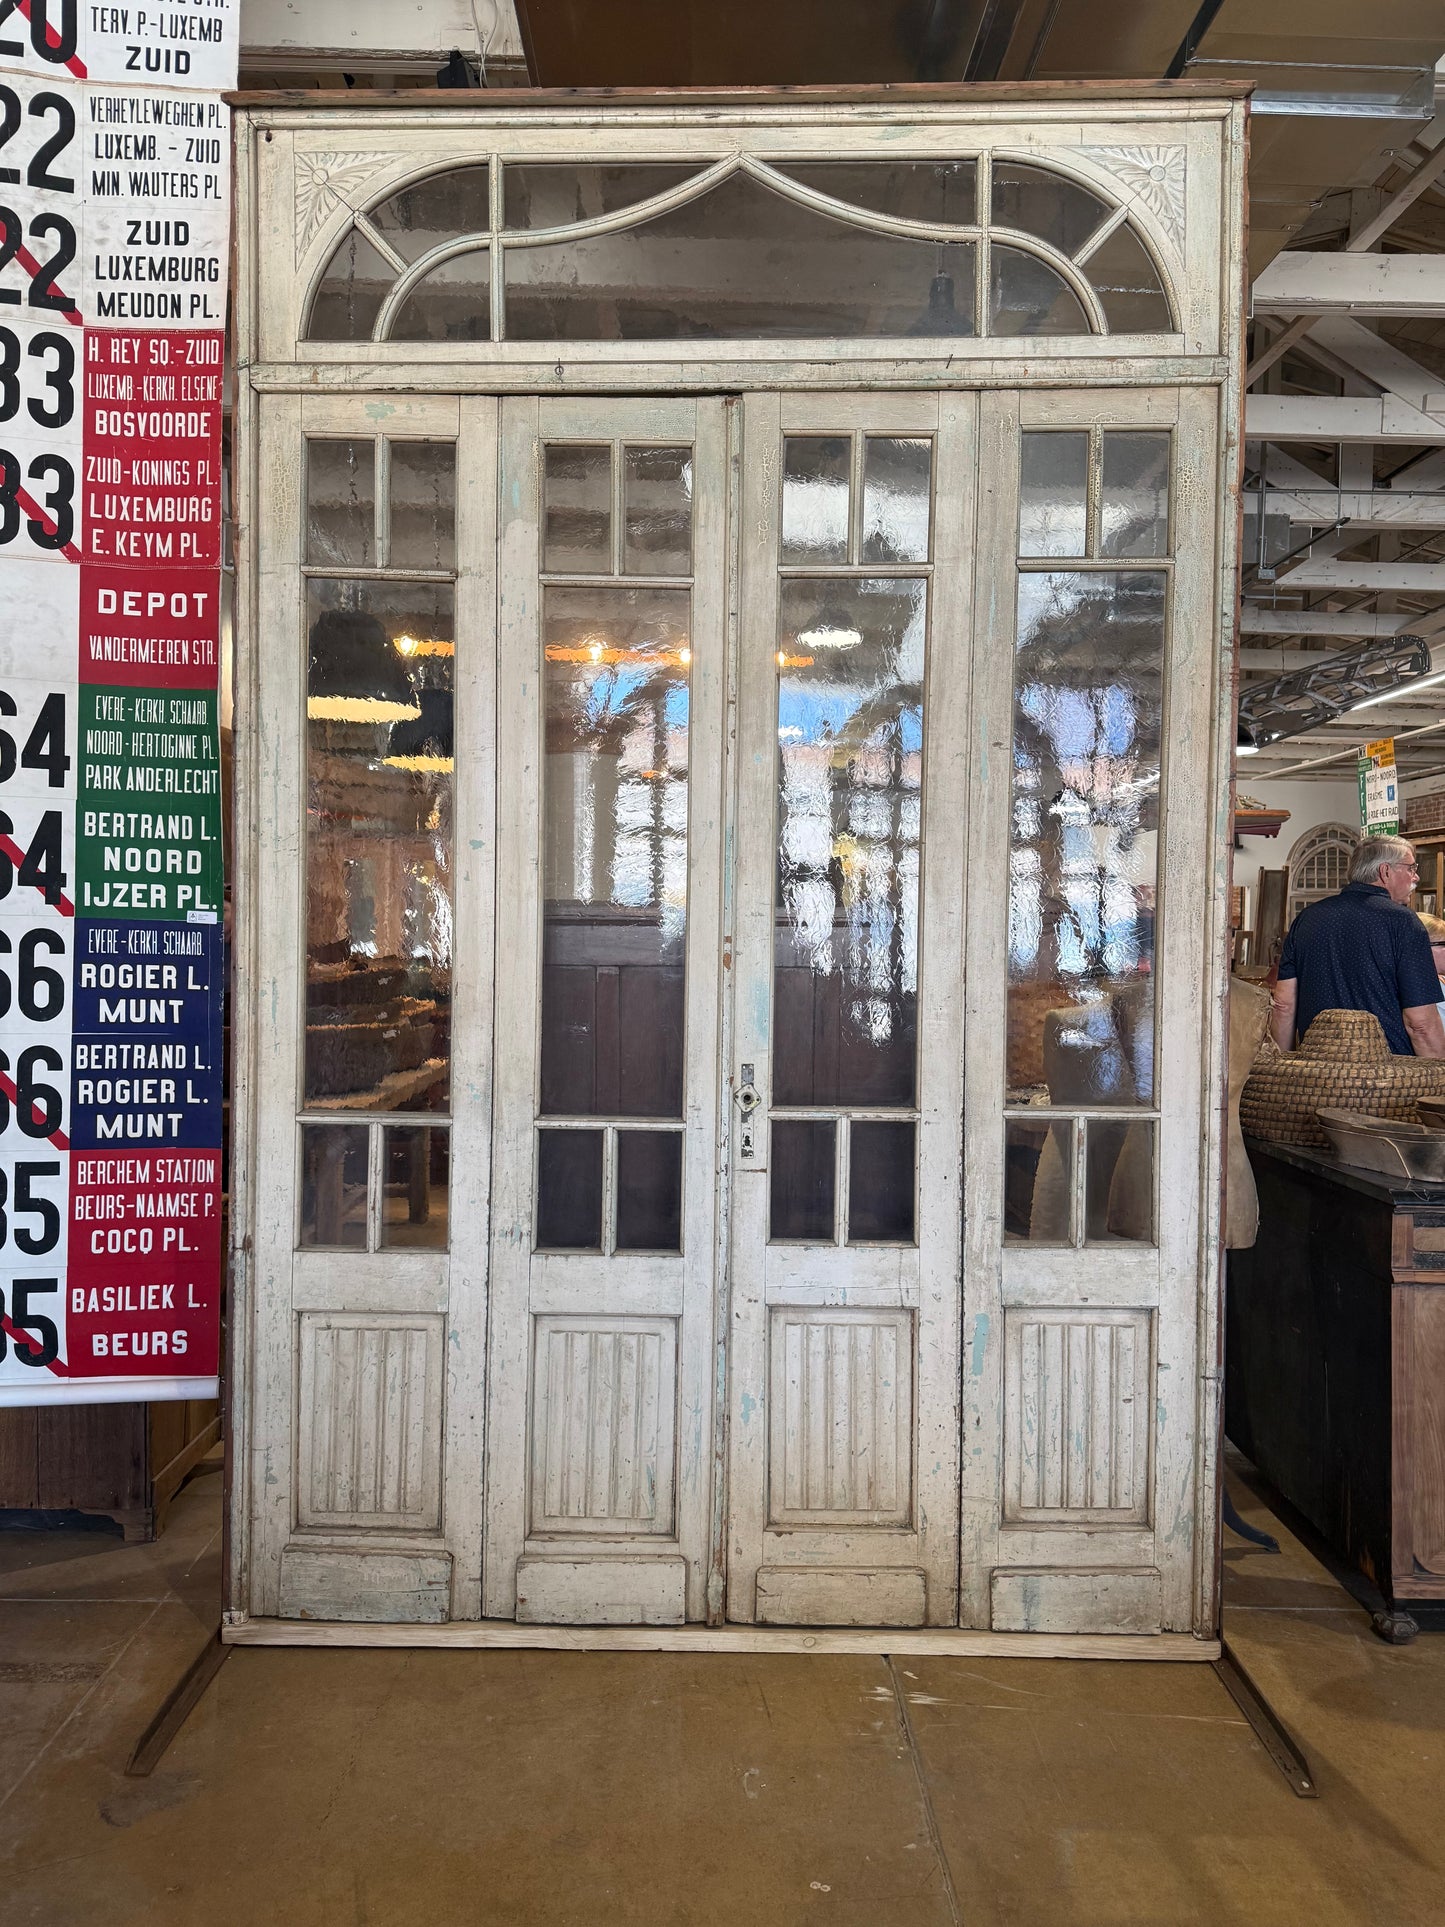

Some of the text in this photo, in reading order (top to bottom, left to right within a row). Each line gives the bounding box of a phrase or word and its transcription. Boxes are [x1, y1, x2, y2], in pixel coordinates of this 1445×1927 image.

[91, 6, 222, 42] TERV. P.-LUXEMB
[126, 46, 190, 74] ZUID
[90, 96, 226, 128] VERHEYLEWEGHEN PL.
[95, 133, 160, 160] LUXEMB.
[185, 137, 220, 163] ZUID
[92, 170, 222, 199] MIN. WAUTERS PL
[126, 220, 190, 246] ZUID
[95, 255, 219, 282] LUXEMBURG
[97, 291, 220, 319] MEUDON PL.
[88, 336, 219, 366] H. REY SQ.-ZUID
[88, 372, 218, 401] LUXEMB.-KERKH. ELSENE
[95, 409, 211, 438] BOSVOORDE
[86, 455, 218, 485] ZUID-KONINGS PL.
[90, 492, 212, 522] LUXEMBURG
[92, 528, 210, 557] E. KEYM PL.
[98, 588, 208, 618] DEPOT
[89, 634, 216, 665] VANDERMEEREN STR.
[170, 699, 209, 725] SCHAARB.
[202, 735, 218, 760] PL.
[85, 764, 218, 794] PARK ANDERLECHT
[84, 811, 217, 841] BERTRAND L.
[104, 846, 202, 875] NOORD
[84, 882, 218, 910] IJZER PL.
[163, 930, 205, 956] SCHAARB.
[0, 928, 66, 1022] 6
[81, 963, 209, 990] ROGIER L.
[99, 998, 184, 1024] MUNT
[75, 1044, 212, 1070] BERTRAND L.
[0, 1045, 63, 1139] 6
[78, 1079, 209, 1105] ROGIER L.
[96, 1113, 183, 1139] MUNT
[77, 1159, 215, 1185] BERCHEM STATION
[0, 1161, 61, 1256] 5
[75, 1193, 215, 1220] BEURS-NAAMSE P.
[91, 1227, 199, 1254] COCQ PL.
[72, 1283, 208, 1313] BASILIEK L.
[0, 1278, 59, 1367] 5
[92, 1330, 188, 1357] BEURS
